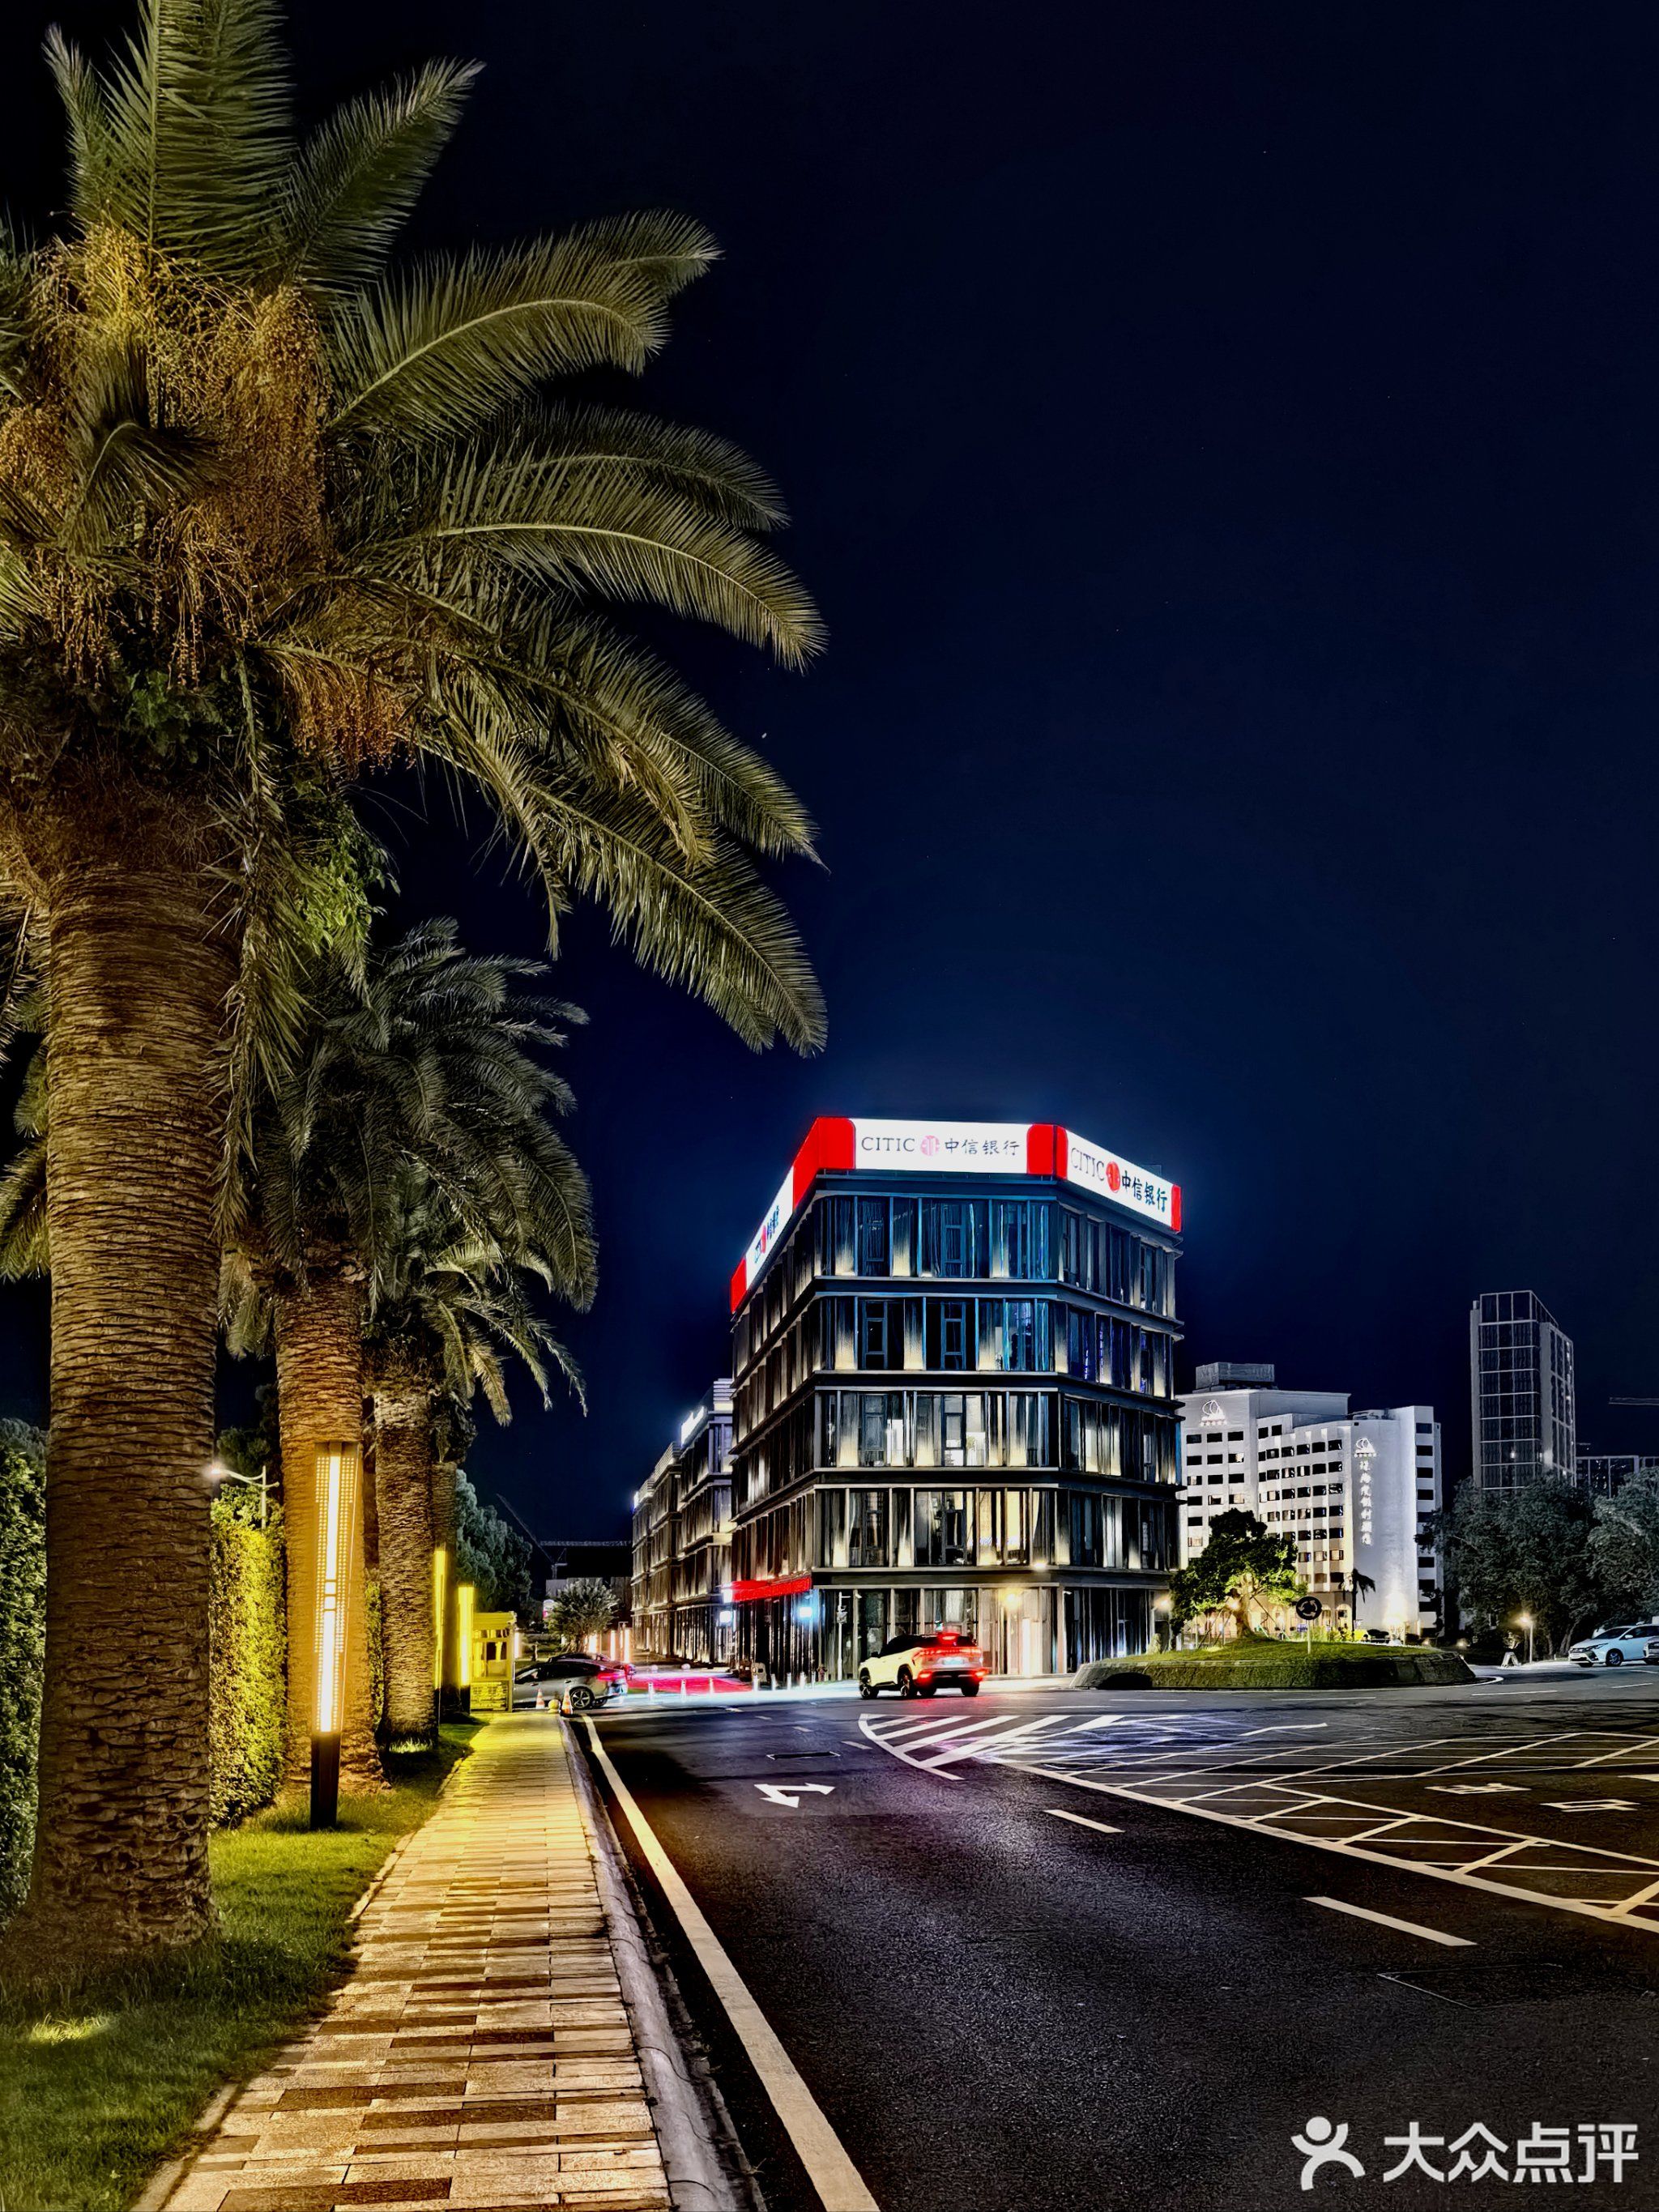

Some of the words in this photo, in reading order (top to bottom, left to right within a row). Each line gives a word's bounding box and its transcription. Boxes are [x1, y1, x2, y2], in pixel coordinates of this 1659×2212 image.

[861, 1136, 915, 1152] CITIC
[945, 1137, 1021, 1156] 中信银行
[1070, 1147, 1105, 1181] CITIC
[1121, 1170, 1168, 1213] 中信银行
